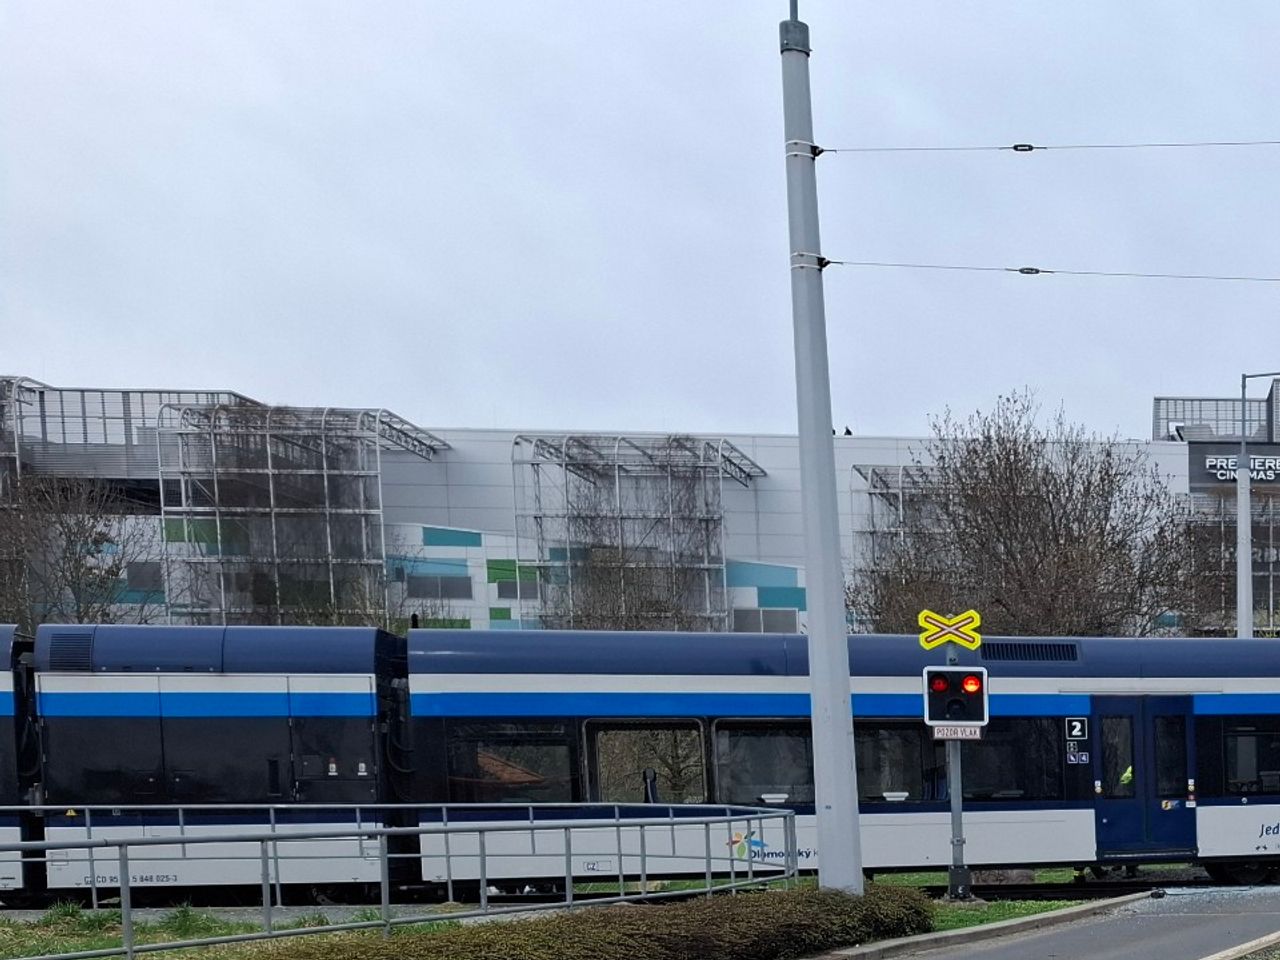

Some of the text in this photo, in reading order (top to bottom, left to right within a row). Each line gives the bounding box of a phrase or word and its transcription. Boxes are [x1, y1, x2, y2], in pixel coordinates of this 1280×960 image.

[1217, 470, 1275, 480] CINMAS
[937, 727, 979, 737] POZOR VLAK
[1070, 721, 1083, 736] 2
